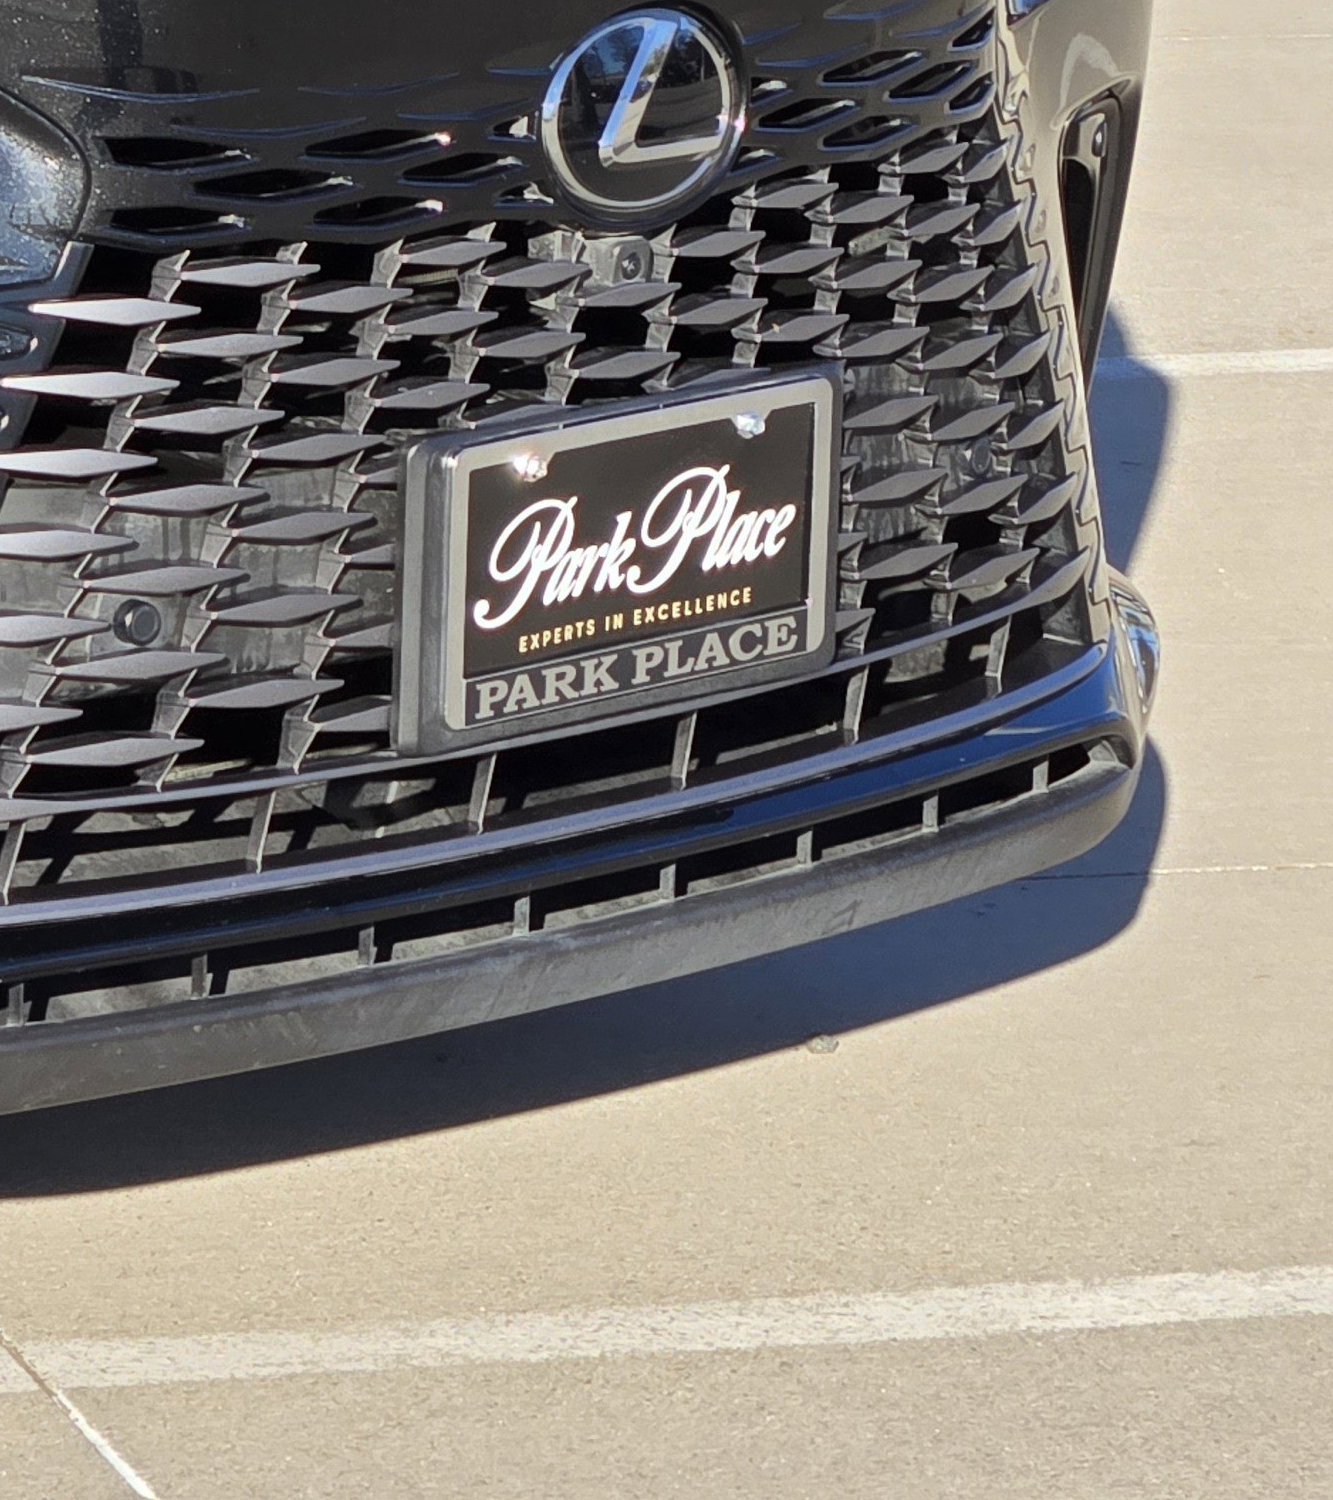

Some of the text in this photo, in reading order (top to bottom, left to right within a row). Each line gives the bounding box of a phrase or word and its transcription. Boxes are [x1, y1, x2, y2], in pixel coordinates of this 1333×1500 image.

[473, 464, 797, 629] Park Place
[474, 615, 799, 720] PARK PLACE
[518, 586, 752, 654] EXPERTS IN EXCELLENCE
